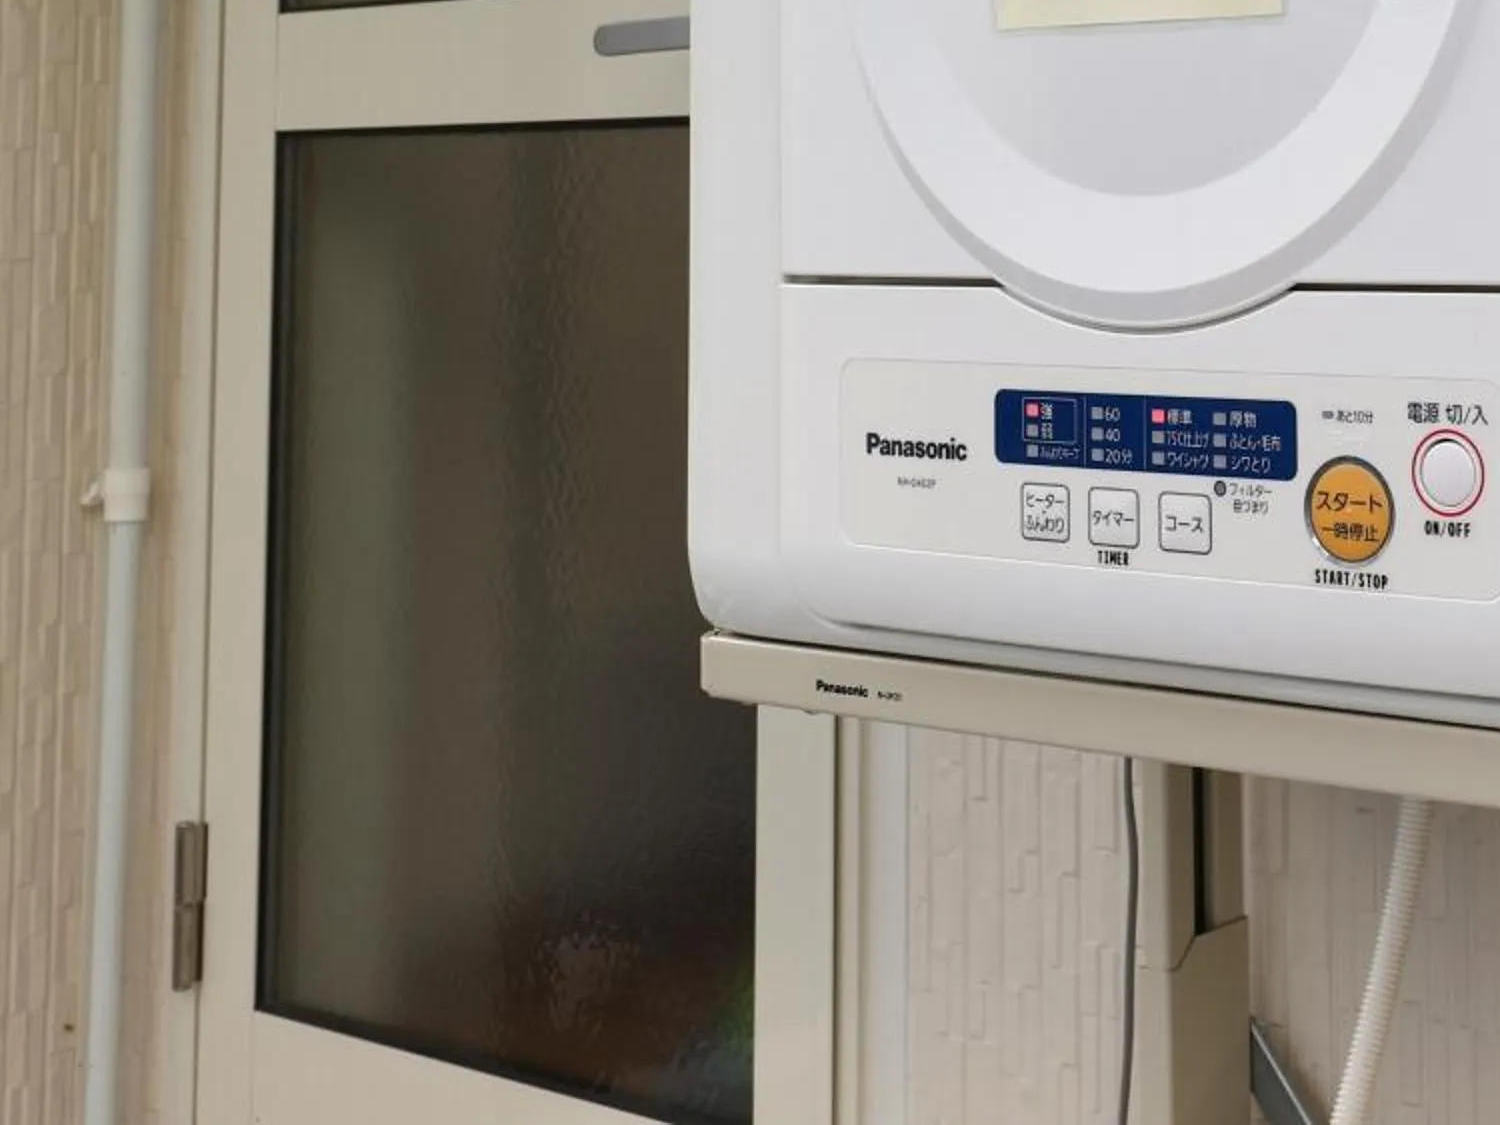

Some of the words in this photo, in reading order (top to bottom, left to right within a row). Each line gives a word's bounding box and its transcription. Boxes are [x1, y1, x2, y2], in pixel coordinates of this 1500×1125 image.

[1407, 402, 1440, 425] 電源
[1446, 403, 1489, 425] 切/入
[866, 432, 968, 462] Panasonic
[1316, 490, 1384, 515] スタート
[1092, 510, 1135, 528] タイマー
[1165, 515, 1205, 533] コース
[1321, 522, 1381, 542] 一時停止
[1097, 550, 1130, 566] TIMER
[1315, 568, 1389, 590] START/STOP
[816, 679, 868, 698] Panasonic
